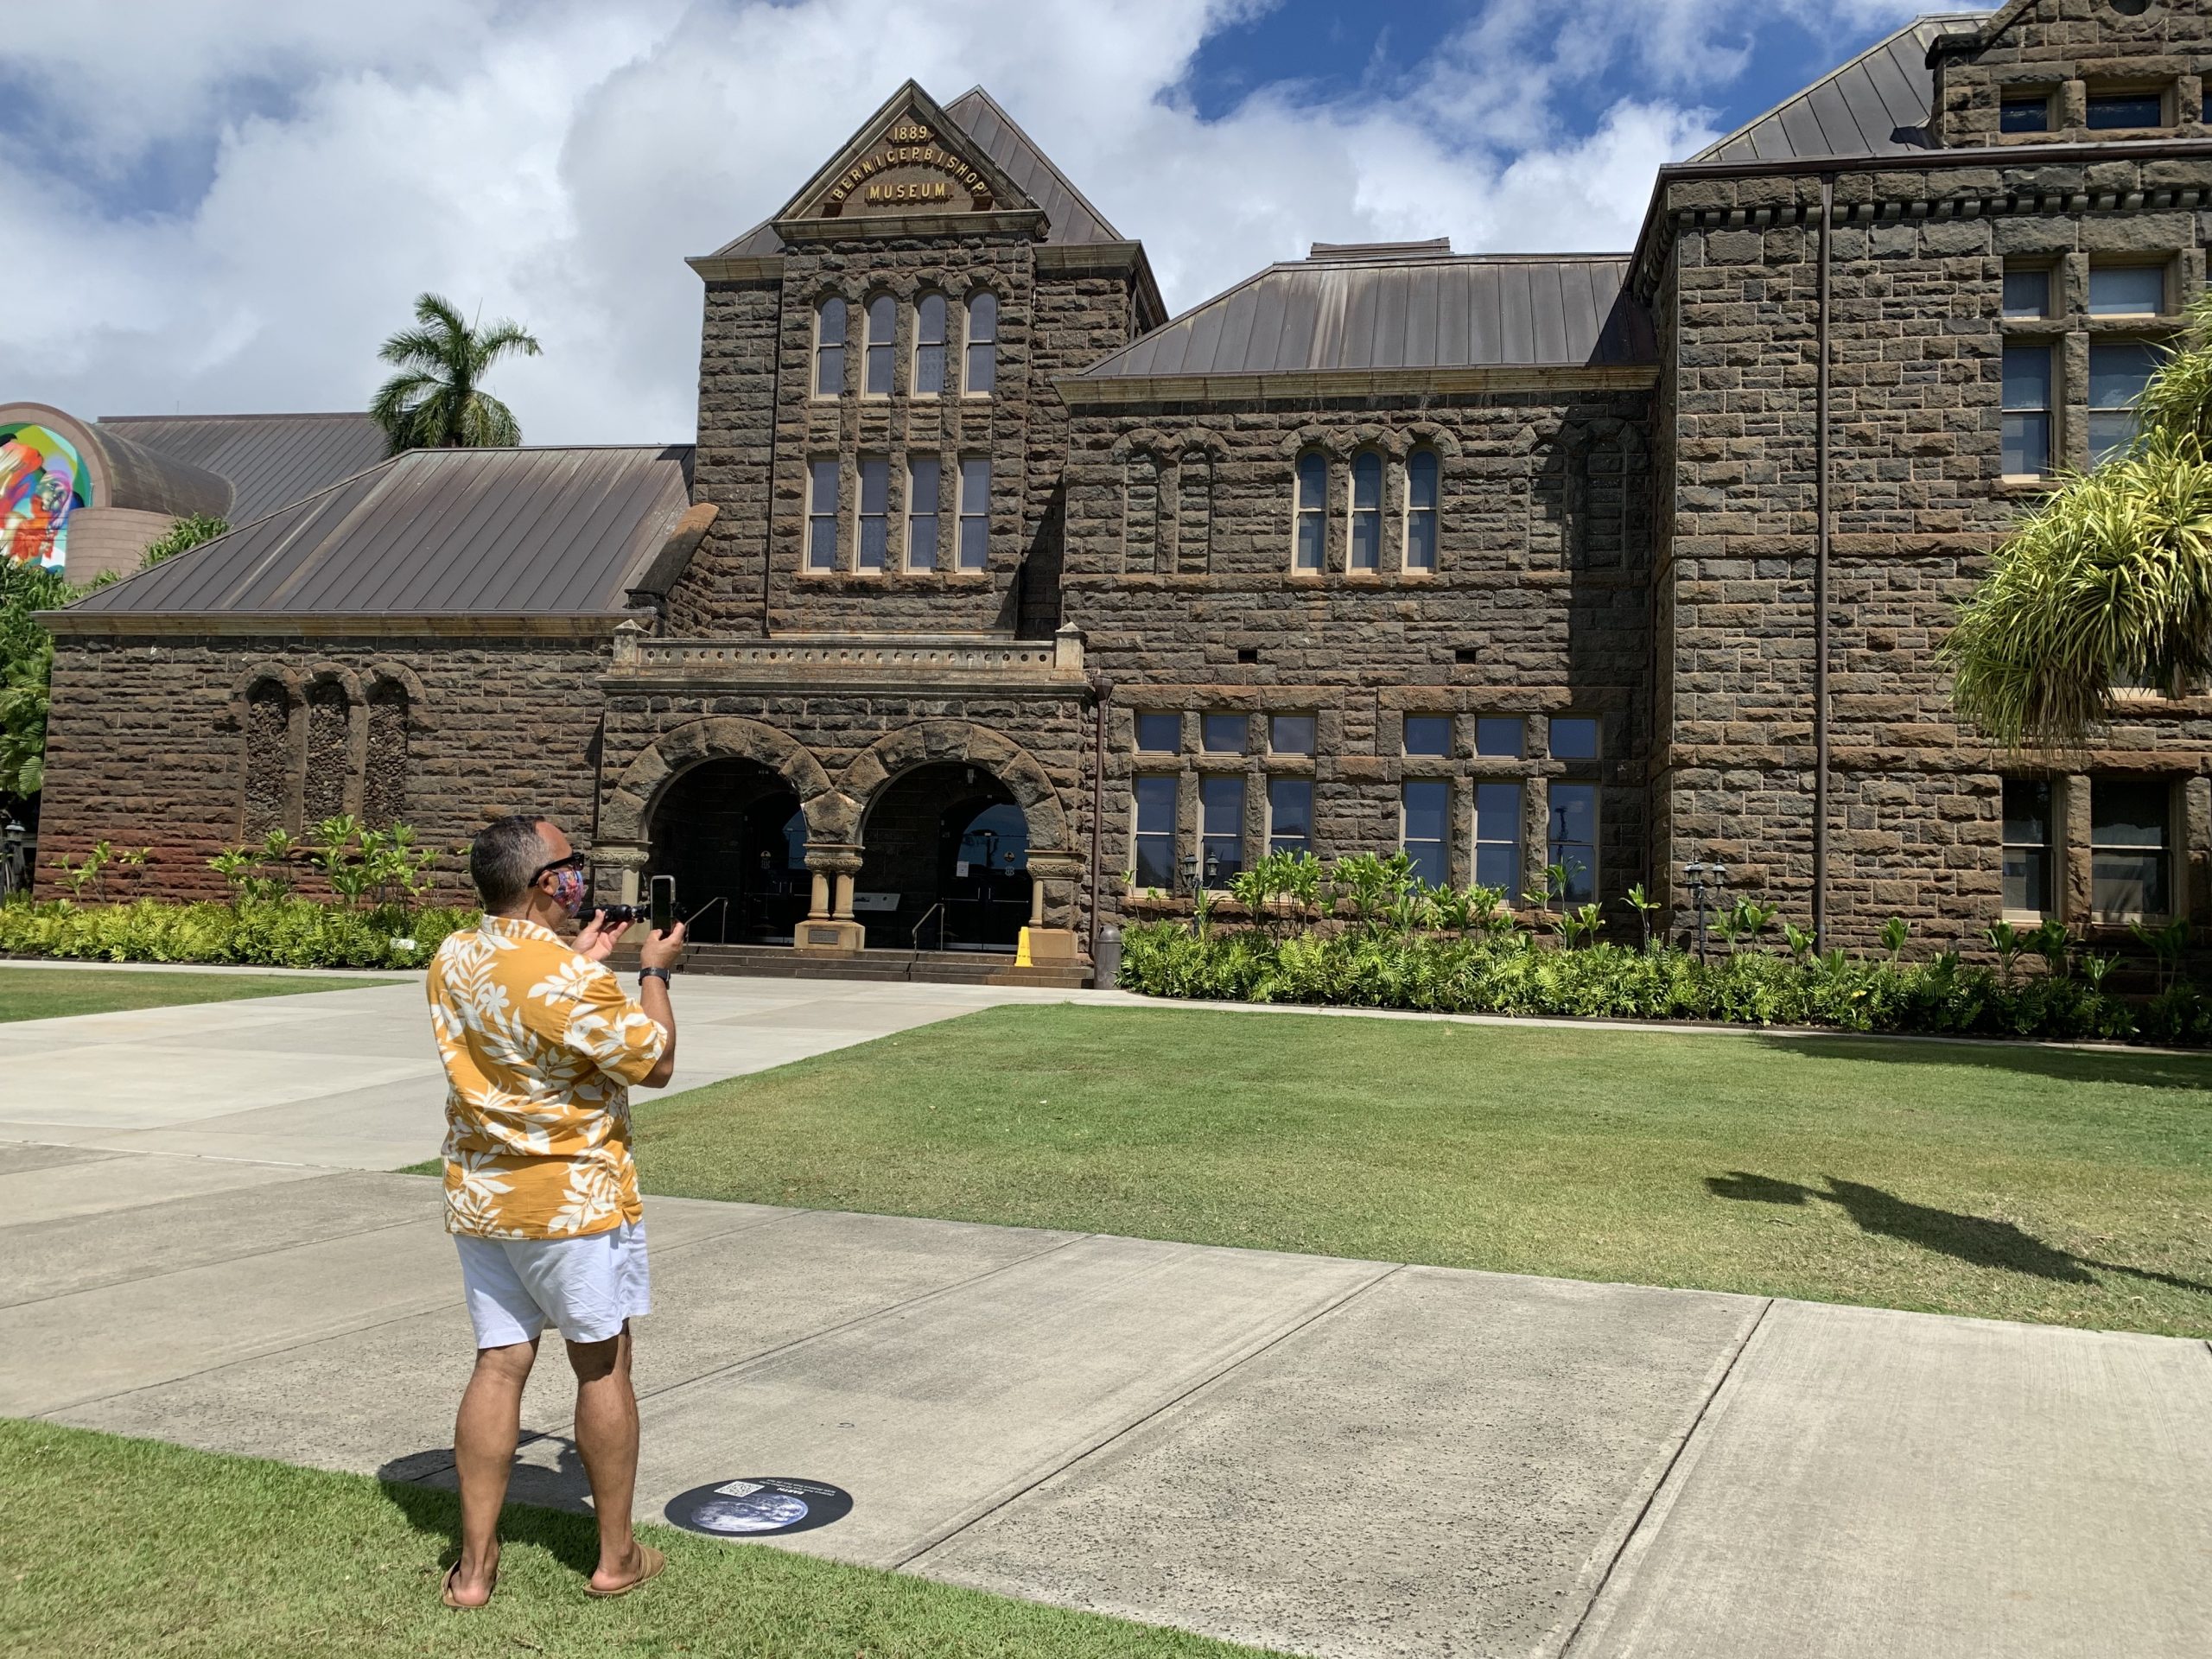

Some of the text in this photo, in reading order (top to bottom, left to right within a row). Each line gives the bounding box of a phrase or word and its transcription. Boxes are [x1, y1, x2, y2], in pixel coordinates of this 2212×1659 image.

[894, 125, 927, 140] 1889
[833, 148, 907, 199] BERNICE
[924, 148, 985, 194] BISHOP
[870, 183, 944, 199] MUSEUM
